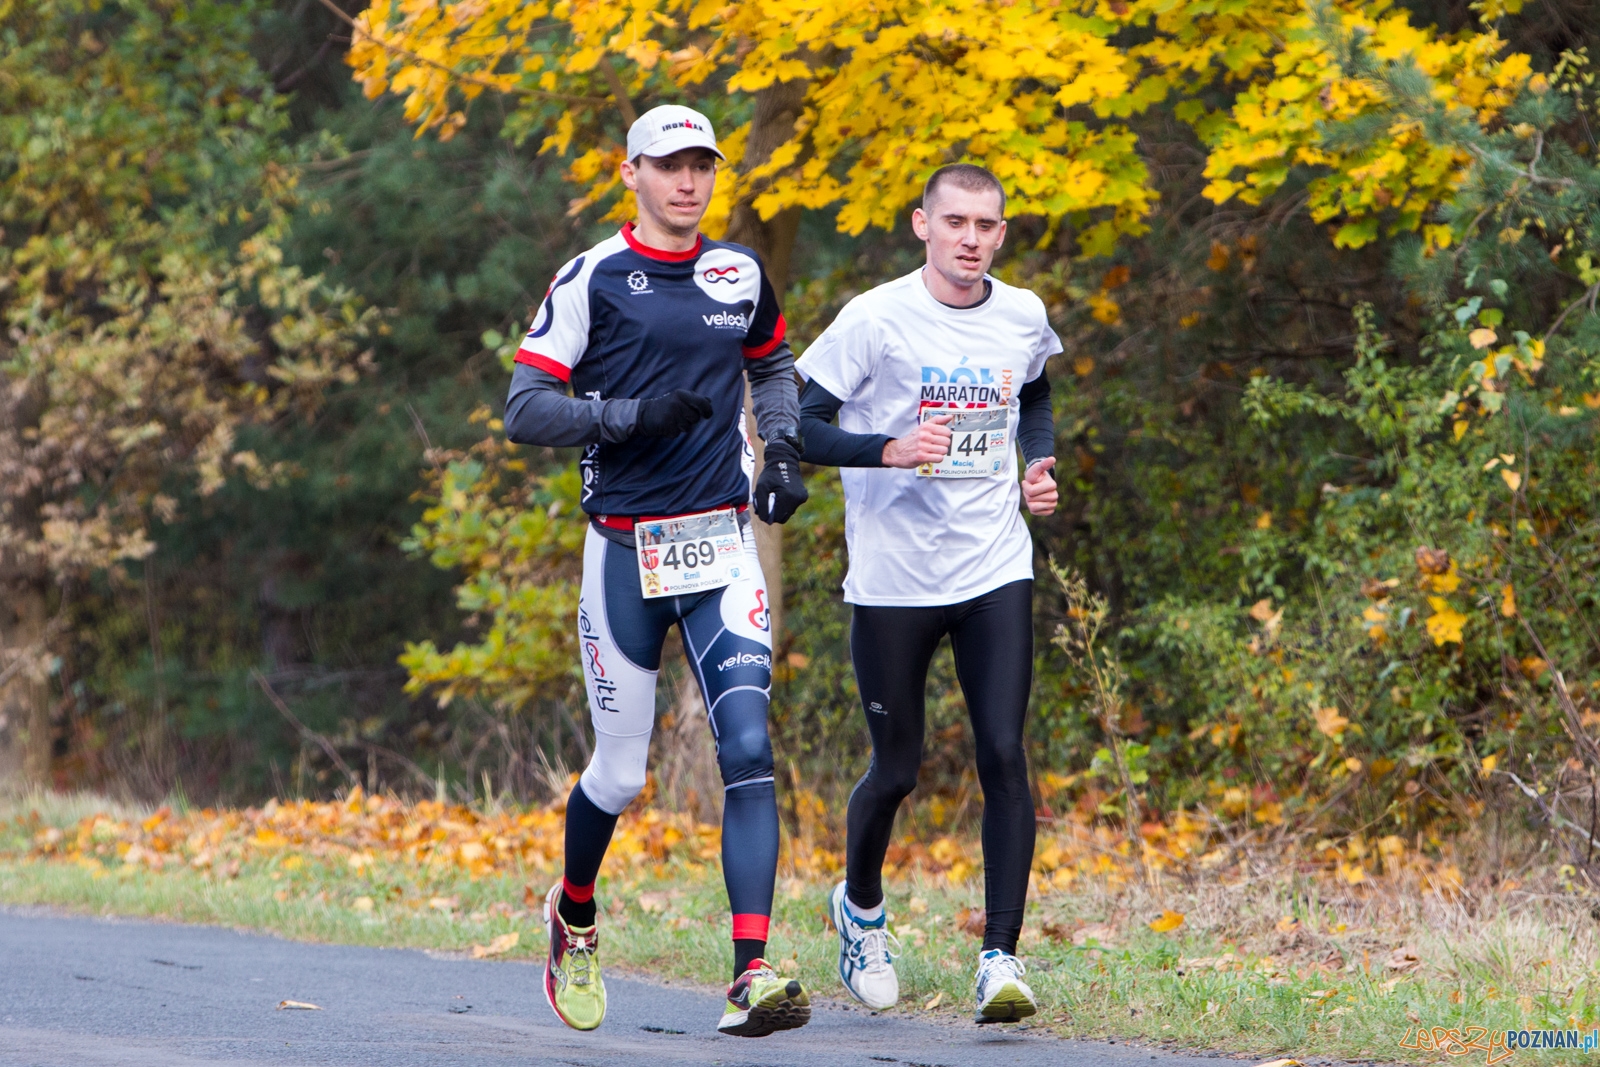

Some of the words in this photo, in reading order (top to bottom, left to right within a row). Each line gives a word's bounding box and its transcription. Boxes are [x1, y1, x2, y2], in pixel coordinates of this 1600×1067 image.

[920, 385, 1001, 403] MARATON
[952, 460, 975, 468] Maciej
[662, 540, 716, 571] 469
[683, 571, 701, 580] Emil
